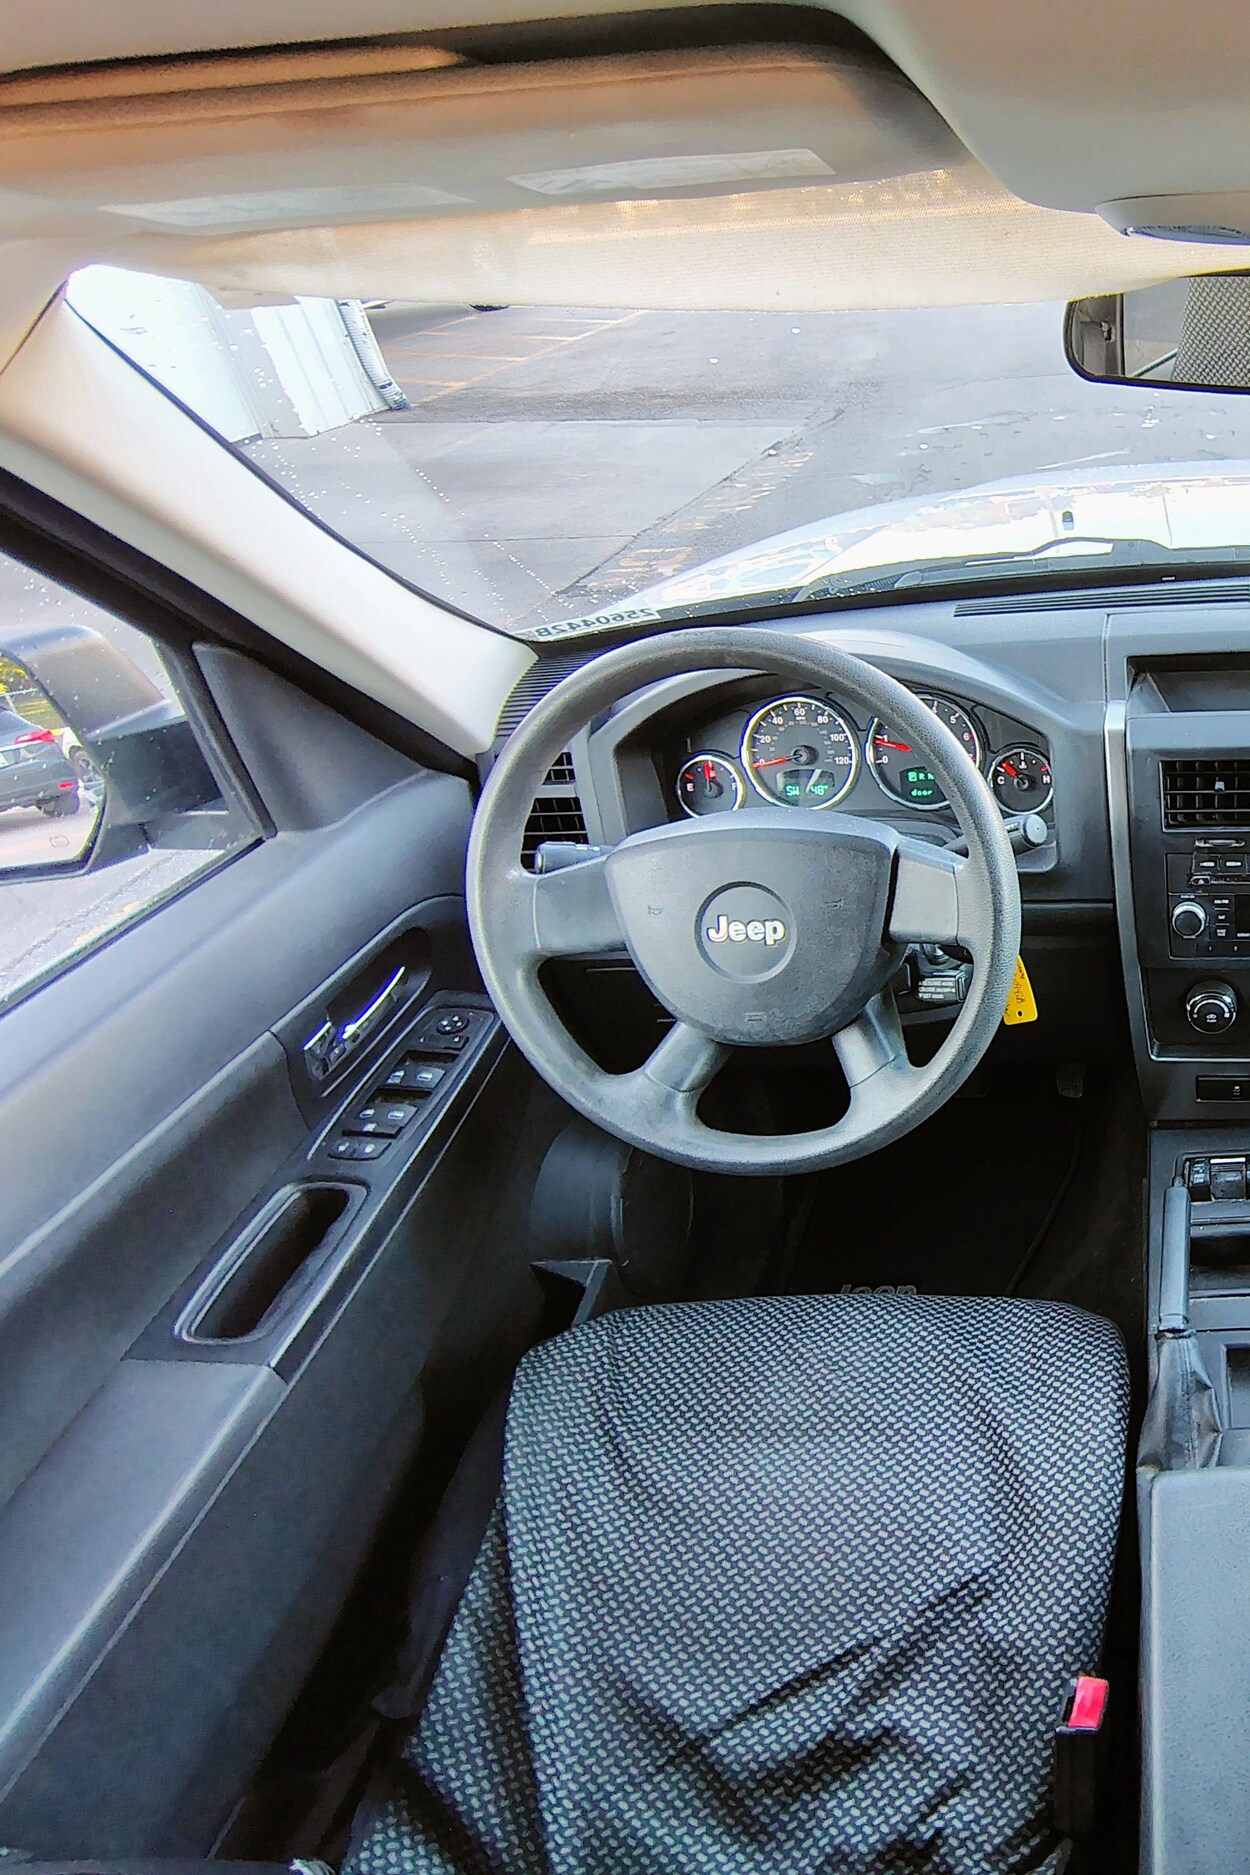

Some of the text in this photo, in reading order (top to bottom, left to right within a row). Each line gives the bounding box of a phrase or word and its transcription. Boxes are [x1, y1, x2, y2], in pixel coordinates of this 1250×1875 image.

[794, 708, 806, 716] 60
[772, 716, 783, 725] 40
[817, 715, 829, 724] 80
[950, 716, 956, 724] 5
[760, 735, 771, 743] 20
[829, 734, 845, 742] 100
[963, 733, 969, 741] 6
[834, 756, 850, 765] 120
[882, 756, 889, 764] 0
[919, 772, 925, 780] R
[997, 776, 1005, 784] C
[1042, 775, 1050, 783] H
[687, 783, 694, 792] E
[786, 786, 800, 796] SW
[911, 788, 934, 796] door
[707, 915, 786, 945] Jeep
